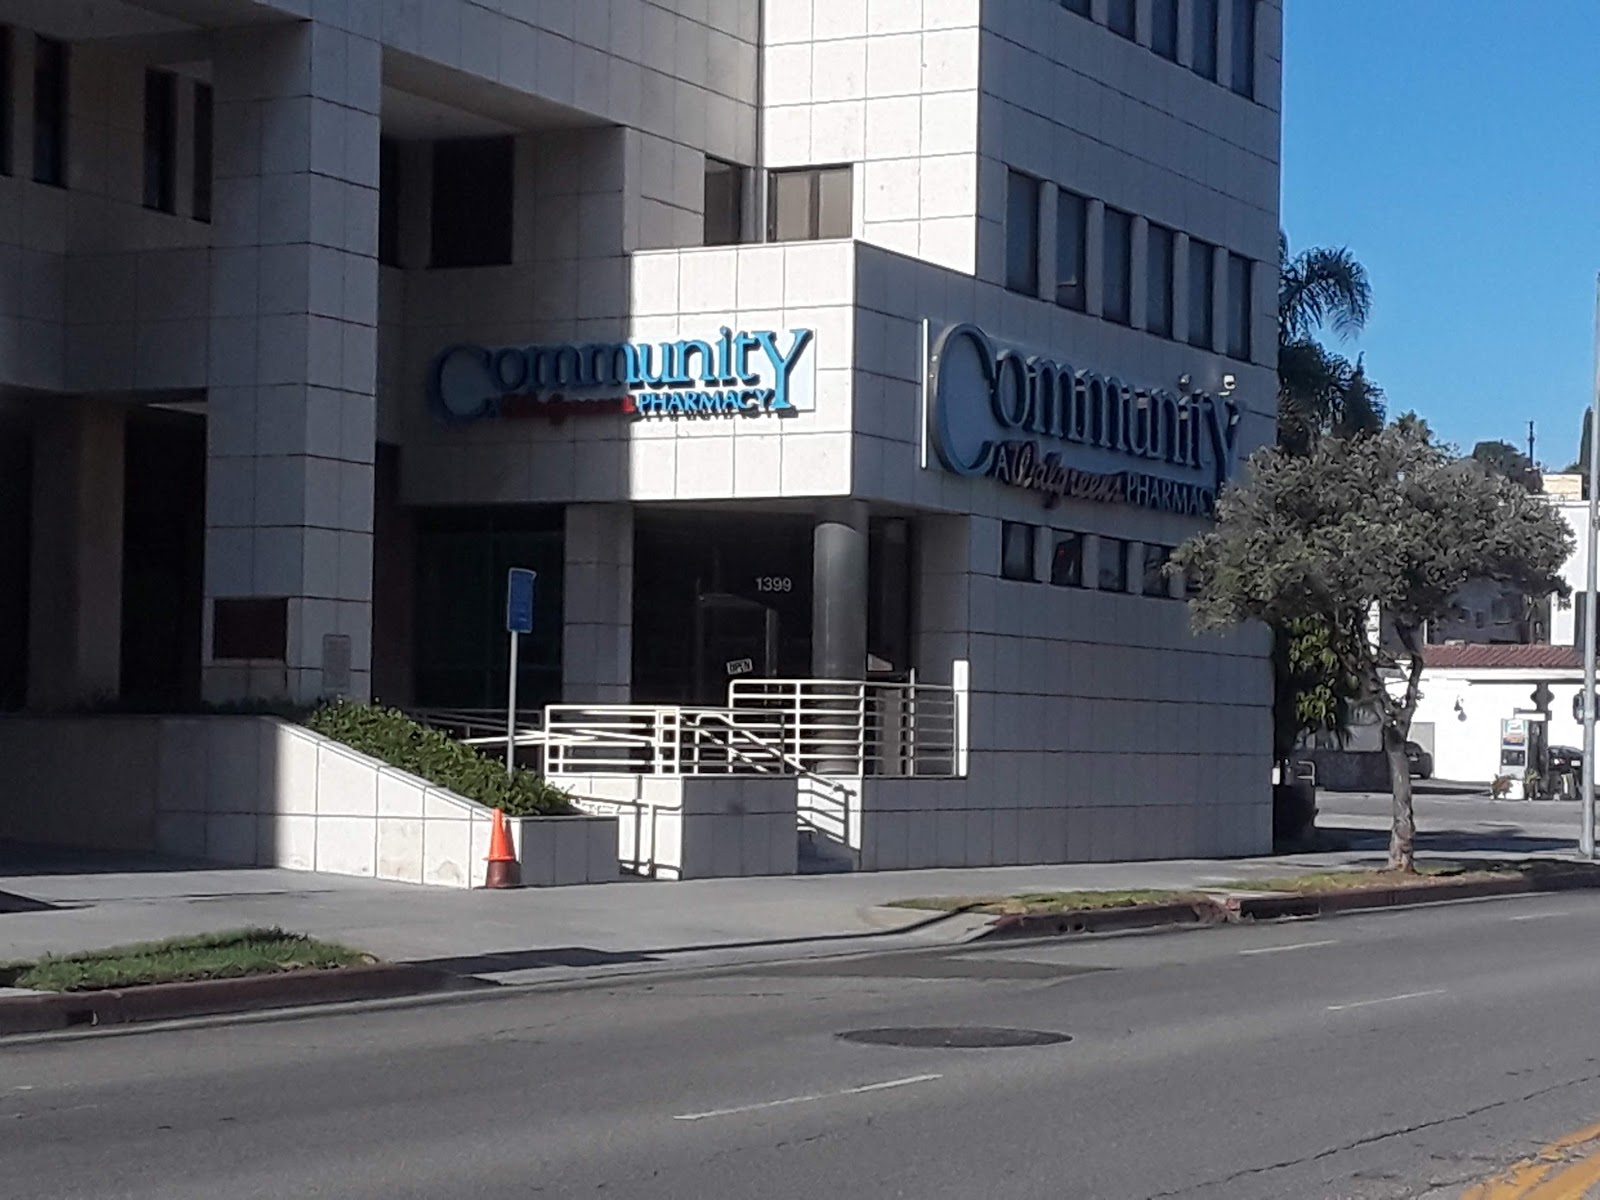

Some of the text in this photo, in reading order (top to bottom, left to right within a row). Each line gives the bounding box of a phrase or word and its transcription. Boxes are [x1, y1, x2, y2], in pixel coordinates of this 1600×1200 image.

[638, 388, 776, 413] PHARMACY
[1126, 472, 1219, 519] PHARMAC
[756, 576, 792, 593] 1399
